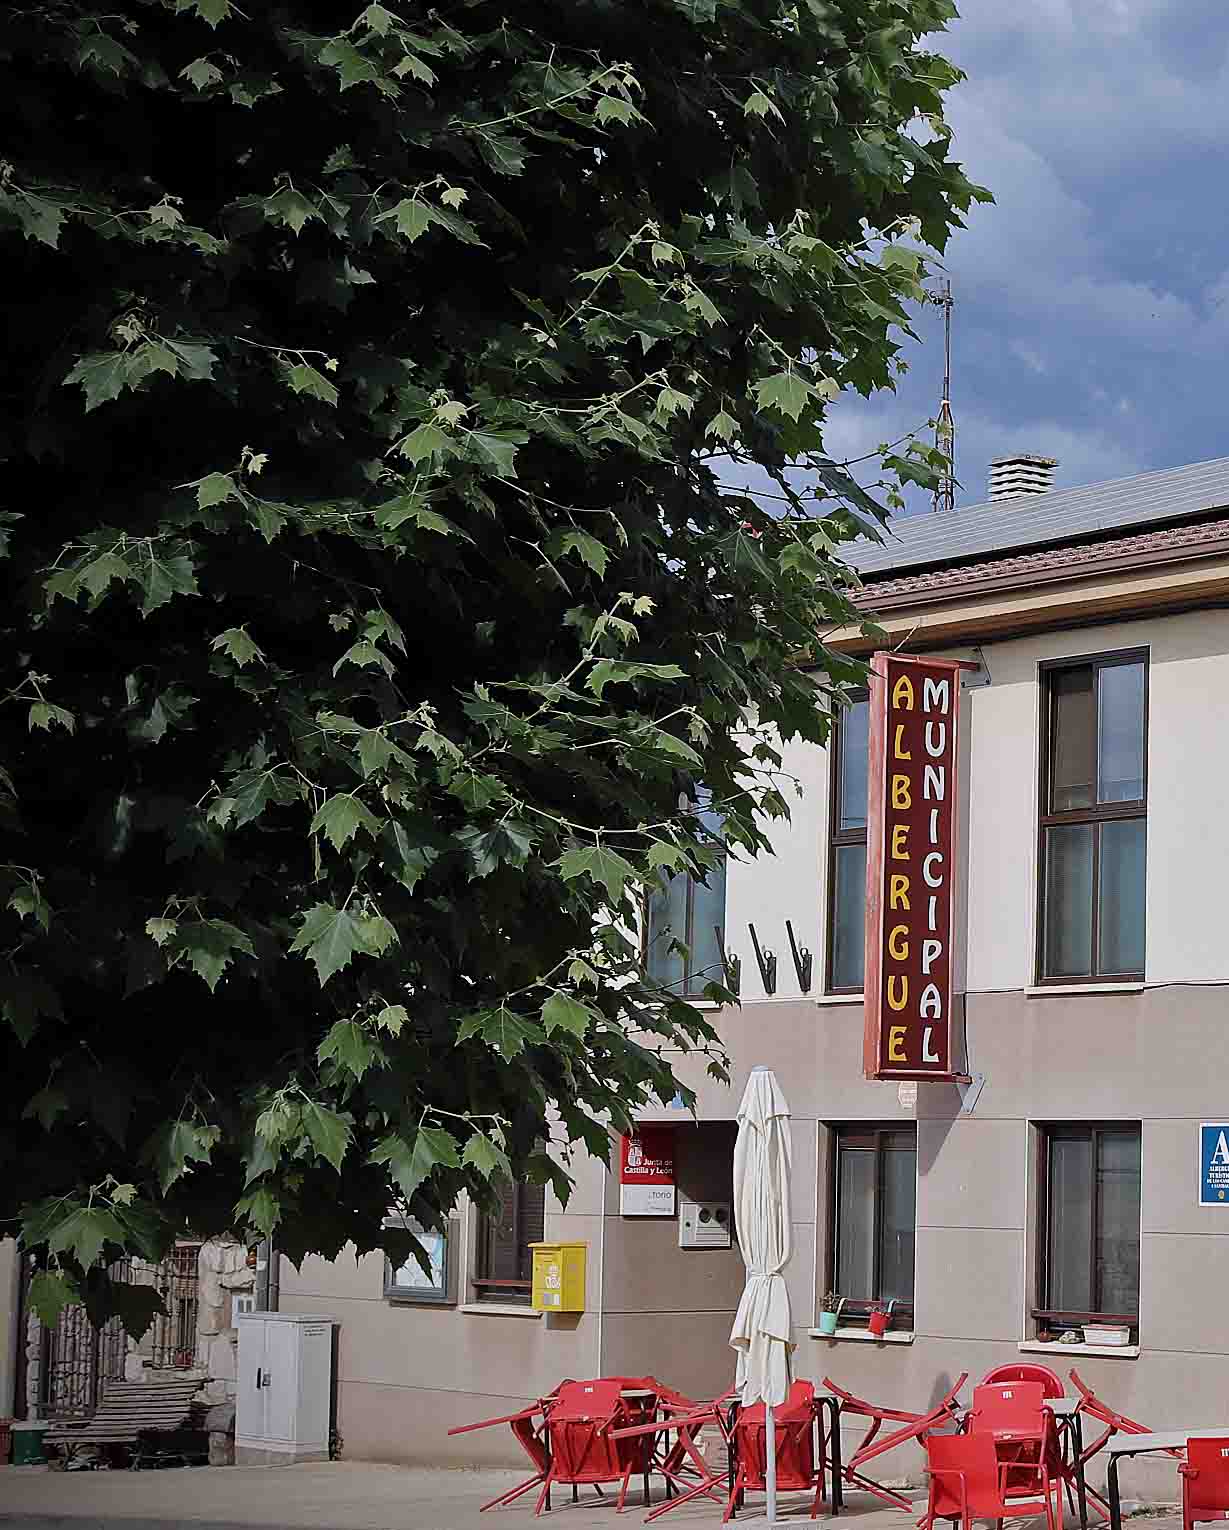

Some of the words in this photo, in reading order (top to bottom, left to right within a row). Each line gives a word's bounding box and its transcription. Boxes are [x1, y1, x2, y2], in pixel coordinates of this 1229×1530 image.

[888, 675, 914, 1062] ALBERGUE
[920, 677, 949, 1062] MUNICIPAL
[624, 1166, 649, 1174] Castilla
